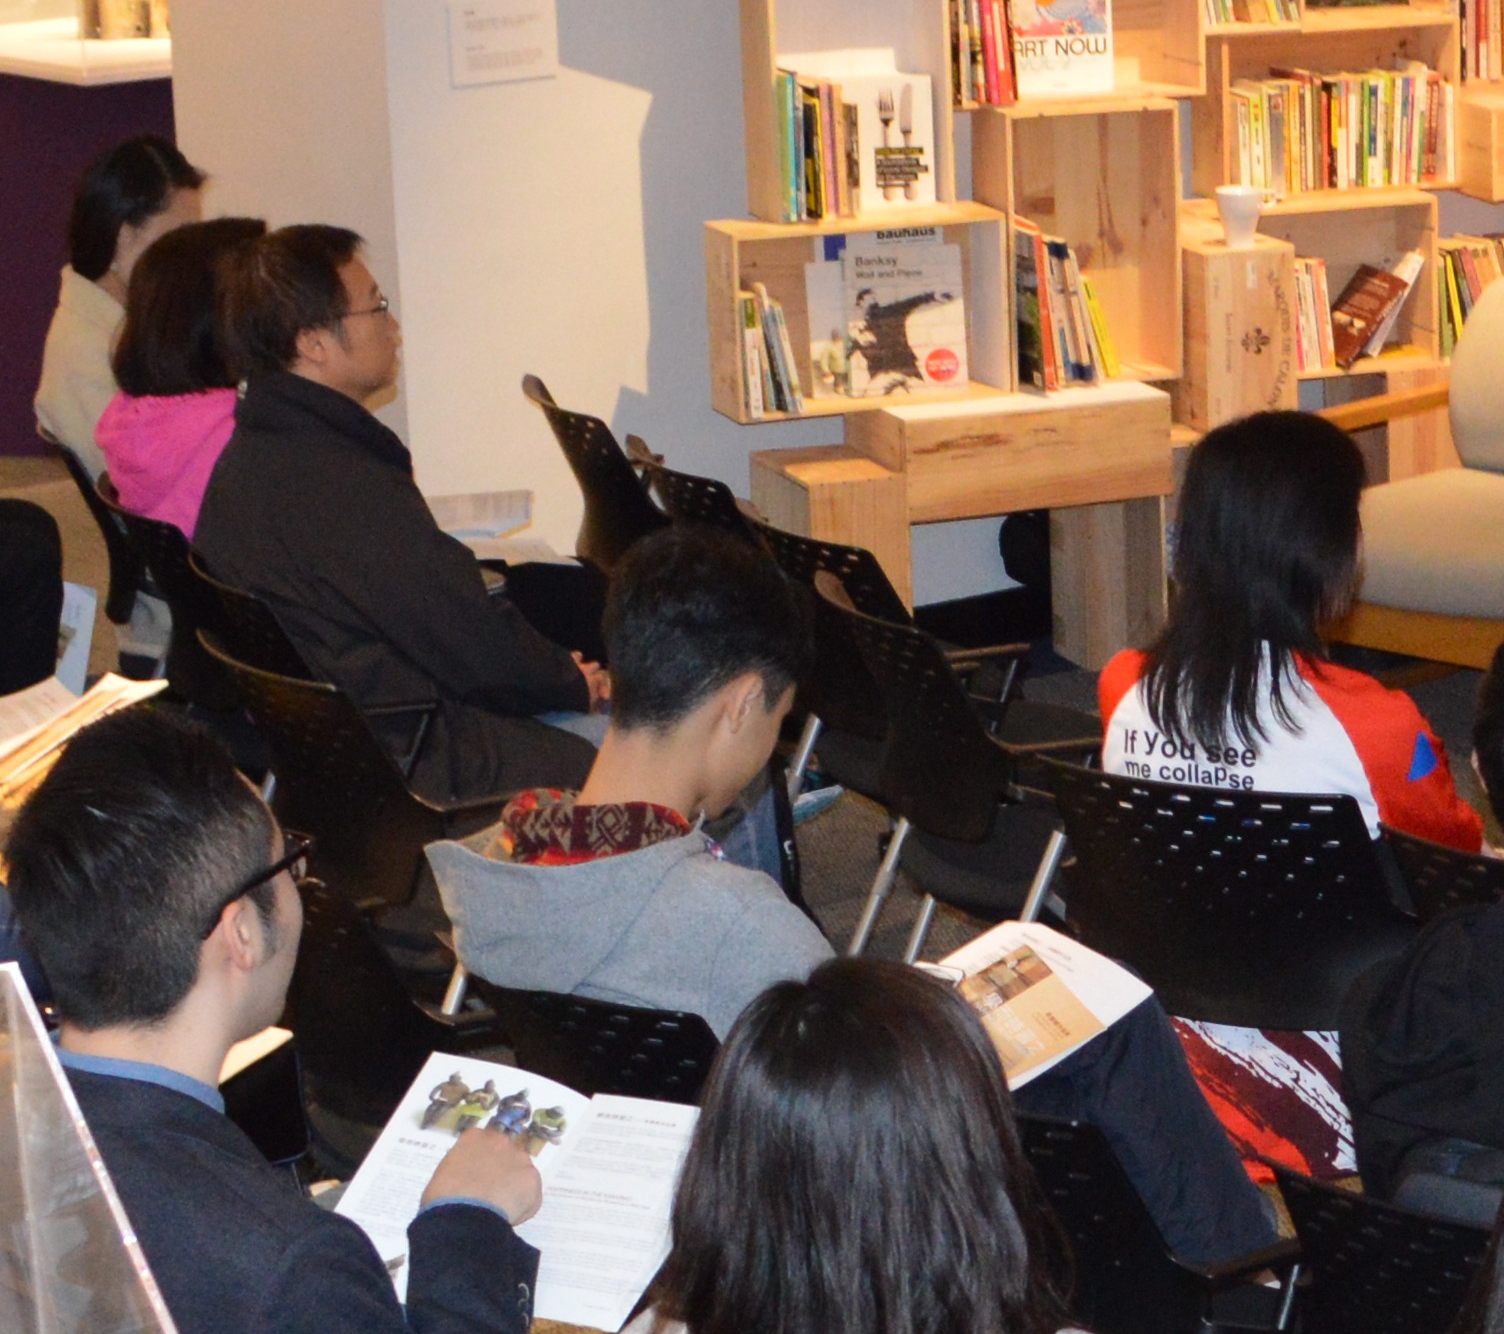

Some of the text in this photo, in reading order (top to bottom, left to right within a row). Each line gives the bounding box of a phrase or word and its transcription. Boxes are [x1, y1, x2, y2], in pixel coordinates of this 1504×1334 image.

[1014, 36, 1107, 58] ART NOW
[876, 226, 936, 240] bauhaus
[855, 255, 898, 267] Banksy
[877, 270, 895, 278] and
[1124, 728, 1138, 754] If
[1206, 744, 1257, 767] see
[1125, 761, 1255, 790] me collapse
